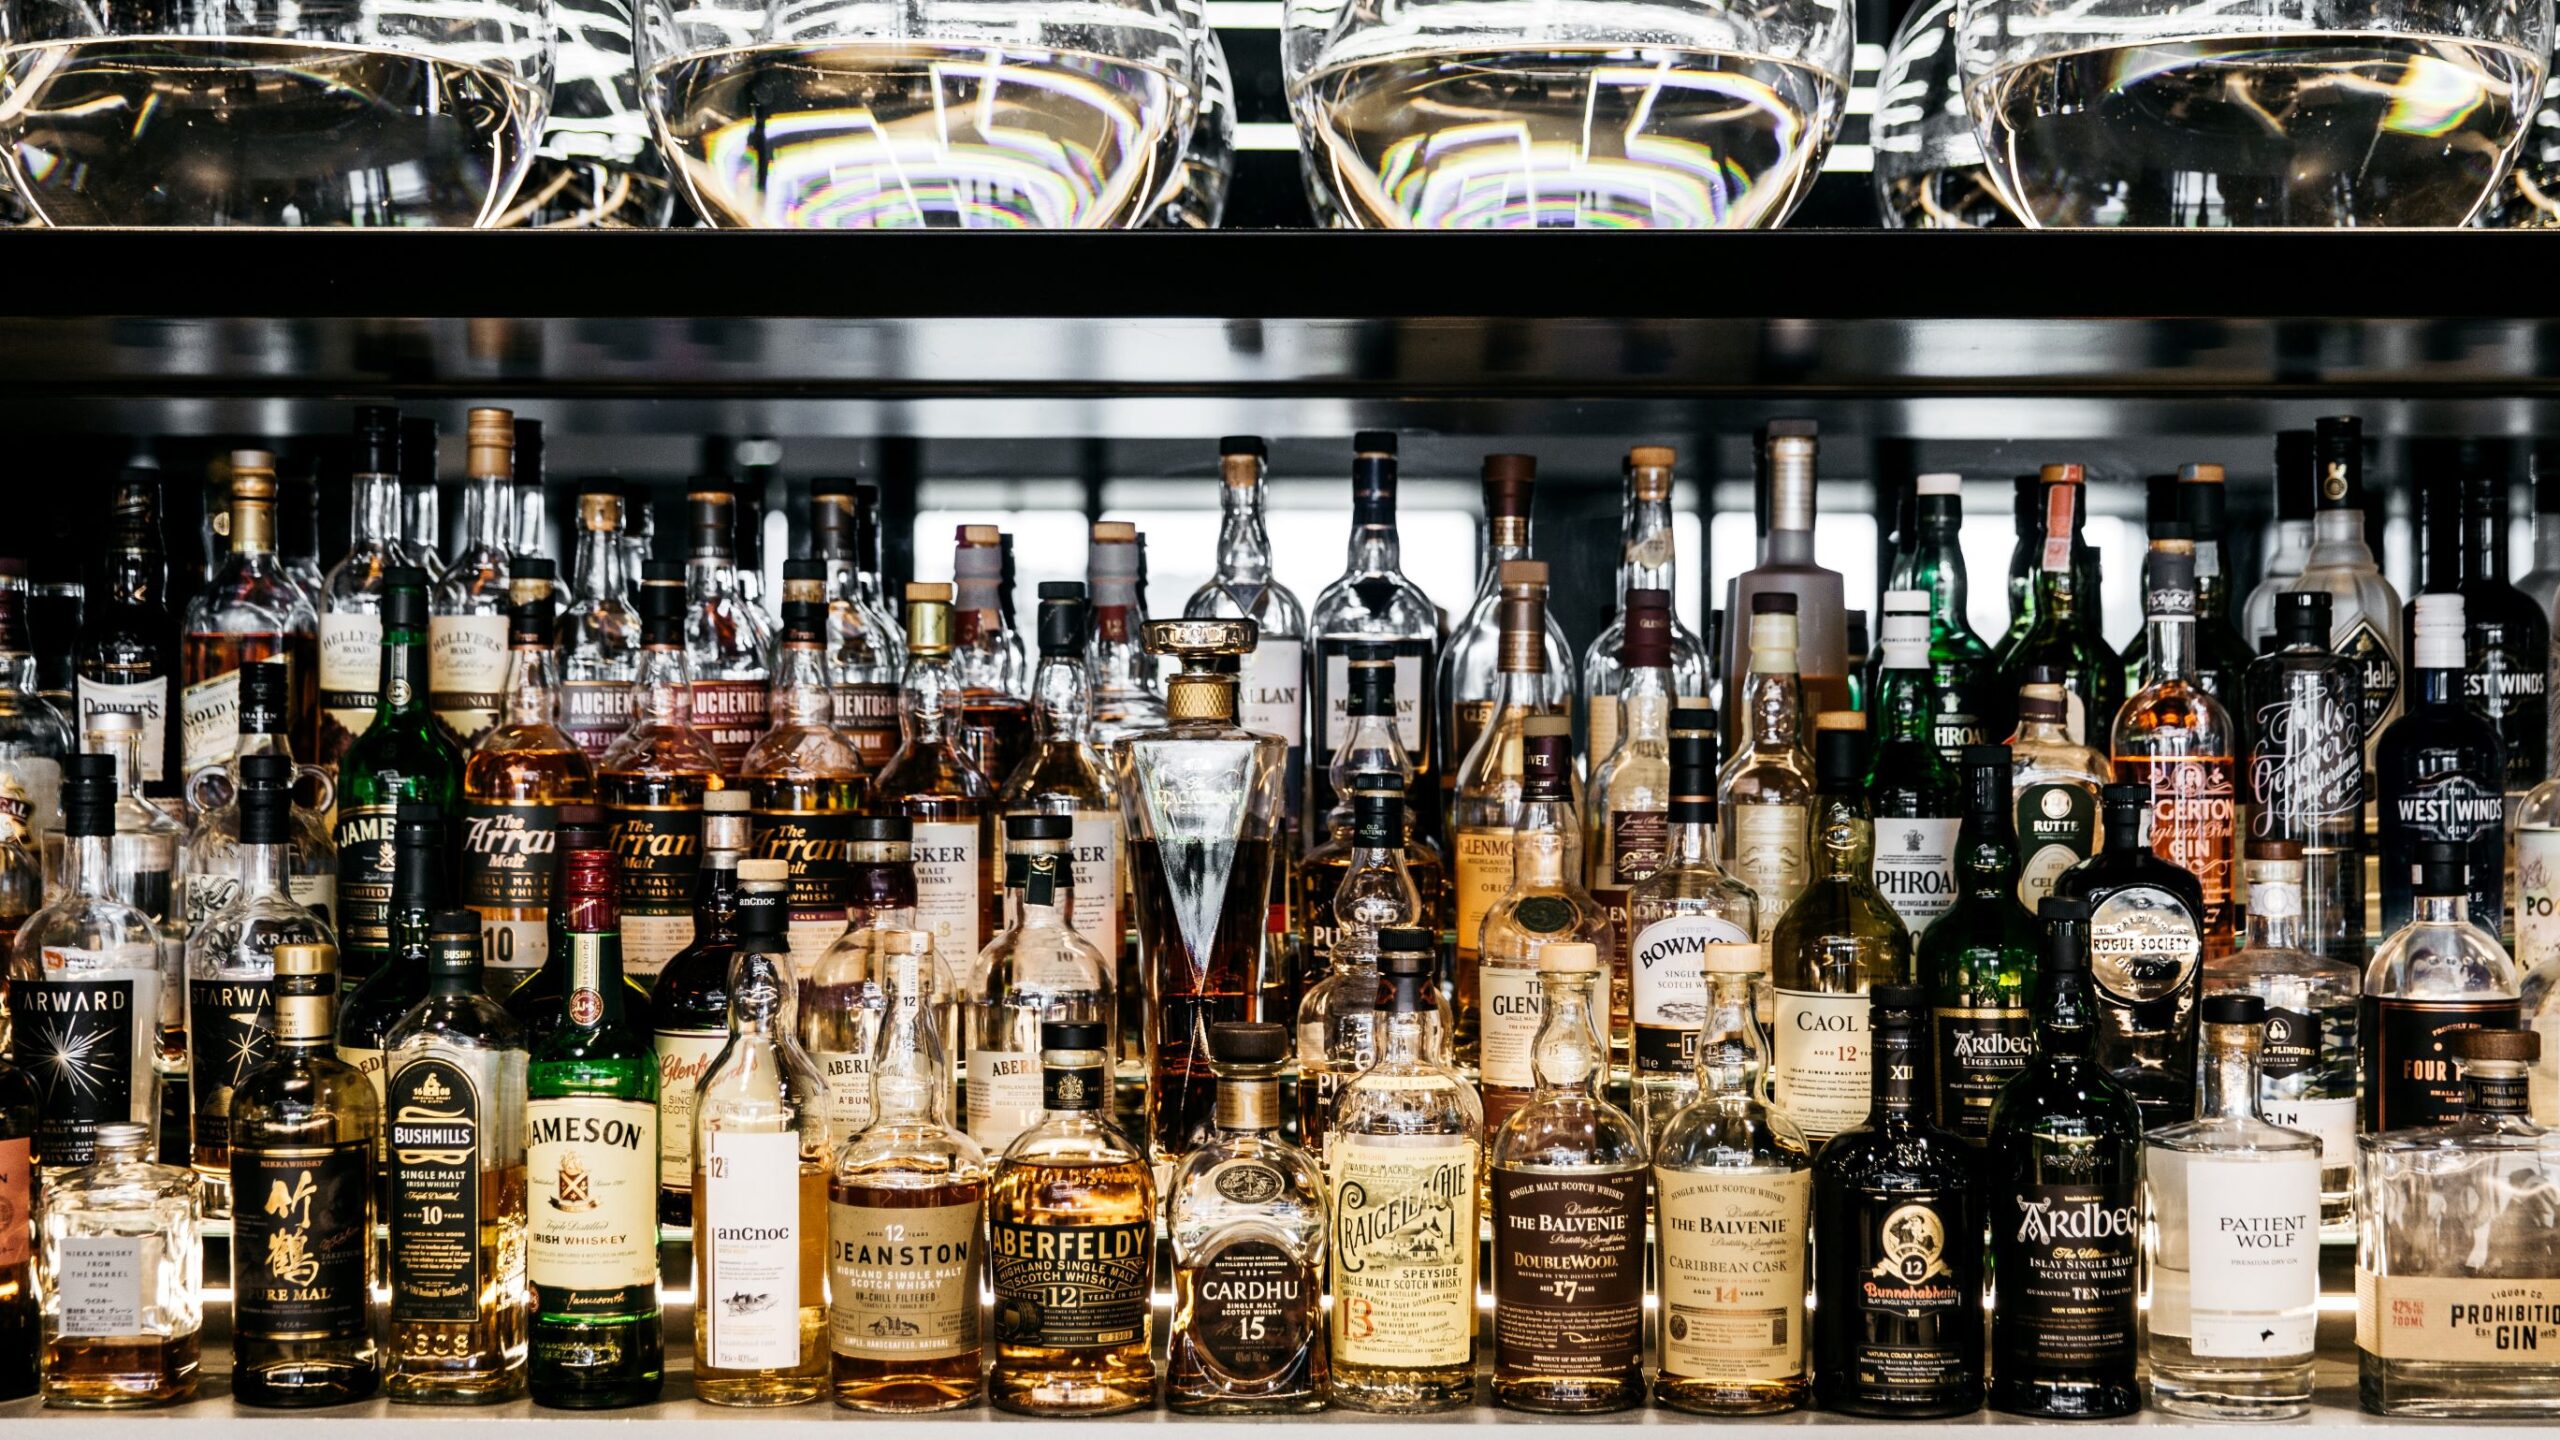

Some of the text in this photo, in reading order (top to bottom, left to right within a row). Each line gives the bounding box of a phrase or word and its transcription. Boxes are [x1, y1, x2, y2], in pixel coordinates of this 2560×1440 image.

[433, 630, 503, 652] HELLYERS
[2364, 660, 2396, 690] delle
[2499, 673, 2545, 694] WINDS
[571, 691, 635, 715] AUCHEN
[2490, 698, 2511, 708] GIN
[712, 730, 751, 745] BLOOD
[2449, 787, 2467, 796] THE
[2155, 799, 2234, 821] GERTON
[2398, 798, 2504, 821] WEST WINDS
[495, 814, 525, 830] The
[628, 819, 654, 833] The
[2033, 819, 2080, 832] RUTTE
[2447, 826, 2468, 835] GIN
[340, 817, 397, 849] JAME
[779, 824, 806, 838] The
[1359, 828, 1388, 836] PULTENEY
[914, 846, 966, 863] SKER
[2168, 840, 2210, 858] GIN
[488, 853, 527, 869] Malt
[623, 856, 656, 870] Malt
[917, 867, 946, 875] MALT
[795, 883, 829, 892] MALT
[739, 895, 776, 907] anCnoc
[788, 893, 836, 902] WHISKY
[1899, 900, 1930, 908] SINGLE
[793, 912, 817, 921] CASK
[483, 926, 515, 963] 10
[1639, 936, 1734, 970] BOWM
[2093, 938, 2192, 951] ROGUE SOCIETY
[1665, 971, 1696, 979] SINGLE
[1657, 981, 1693, 990] SCOTCH
[190, 987, 271, 1006] STARWA
[903, 996, 917, 1008] 12
[1796, 1011, 1859, 1033] CAOL
[1837, 1044, 1858, 1063] 12
[2272, 1046, 2316, 1056] FLINDERS
[827, 1060, 871, 1078] ABERL
[1890, 1065, 1914, 1080] XII
[2403, 1059, 2447, 1082] FOUR
[2481, 1085, 2508, 1095] SMALL
[2482, 1096, 2516, 1107] PREMIUM
[394, 1126, 471, 1146] BUSHMILLS
[527, 1116, 642, 1150] JAMESON
[400, 1170, 466, 1180] SINGLE MALT
[709, 1156, 723, 1179] 12
[406, 1180, 460, 1188] IRISH WHISKEY
[1508, 1181, 1625, 1202] SINGLE MALT SCOTCH WHISKY
[1671, 1184, 1787, 1204] SINGLE MALT SCOTCH WHISKY
[421, 1206, 443, 1225] 10
[1338, 1162, 1467, 1272] CRAIGELLACHIE
[1508, 1214, 1627, 1232] THE BALVENIE
[2220, 1214, 2307, 1233] PATIENT
[264, 1170, 320, 1287] 竹鶴
[718, 1225, 789, 1241] anCnoc
[884, 1223, 905, 1242] 12
[1671, 1217, 1789, 1234] THE BALVENIE
[533, 1233, 627, 1245] IRISH WHISKEY
[993, 1225, 1147, 1262] ABERFELDY
[2236, 1232, 2296, 1249] WOLF
[999, 1259, 1136, 1283] HIGHLAND SINGLE MALT
[1669, 1256, 1787, 1274] CARIBBEAN CASK
[1904, 1260, 1924, 1277] 12
[2029, 1255, 2134, 1270] ISLAY SINGLE MALT
[887, 1268, 934, 1281] SINGLE
[936, 1264, 962, 1279] MALT
[1013, 1271, 1116, 1289] SCOTCH WHISKY
[1402, 1267, 1459, 1279] SPEYSIDE
[2039, 1268, 2128, 1281] SCOTCH WHISKY
[850, 1277, 943, 1290] SCOTCH WHISKY
[1202, 1280, 1299, 1301] CARDHU
[1339, 1274, 1463, 1290] SINGLE MALT SCOTCH WHISKY
[1048, 1286, 1116, 1308] 12 YEARS
[1552, 1281, 1579, 1304] 17
[1714, 1285, 1739, 1304] 14
[1863, 1282, 1958, 1300] Bunnahabhain
[2072, 1287, 2101, 1301] TEN
[2491, 1289, 2526, 1300] LIQUOR
[1341, 1297, 1374, 1339] 13
[1907, 1308, 1920, 1318] XII
[2451, 1303, 2560, 1328] PROHIBITIO
[1240, 1315, 1266, 1340] 15
[2496, 1325, 2538, 1350] GIN
